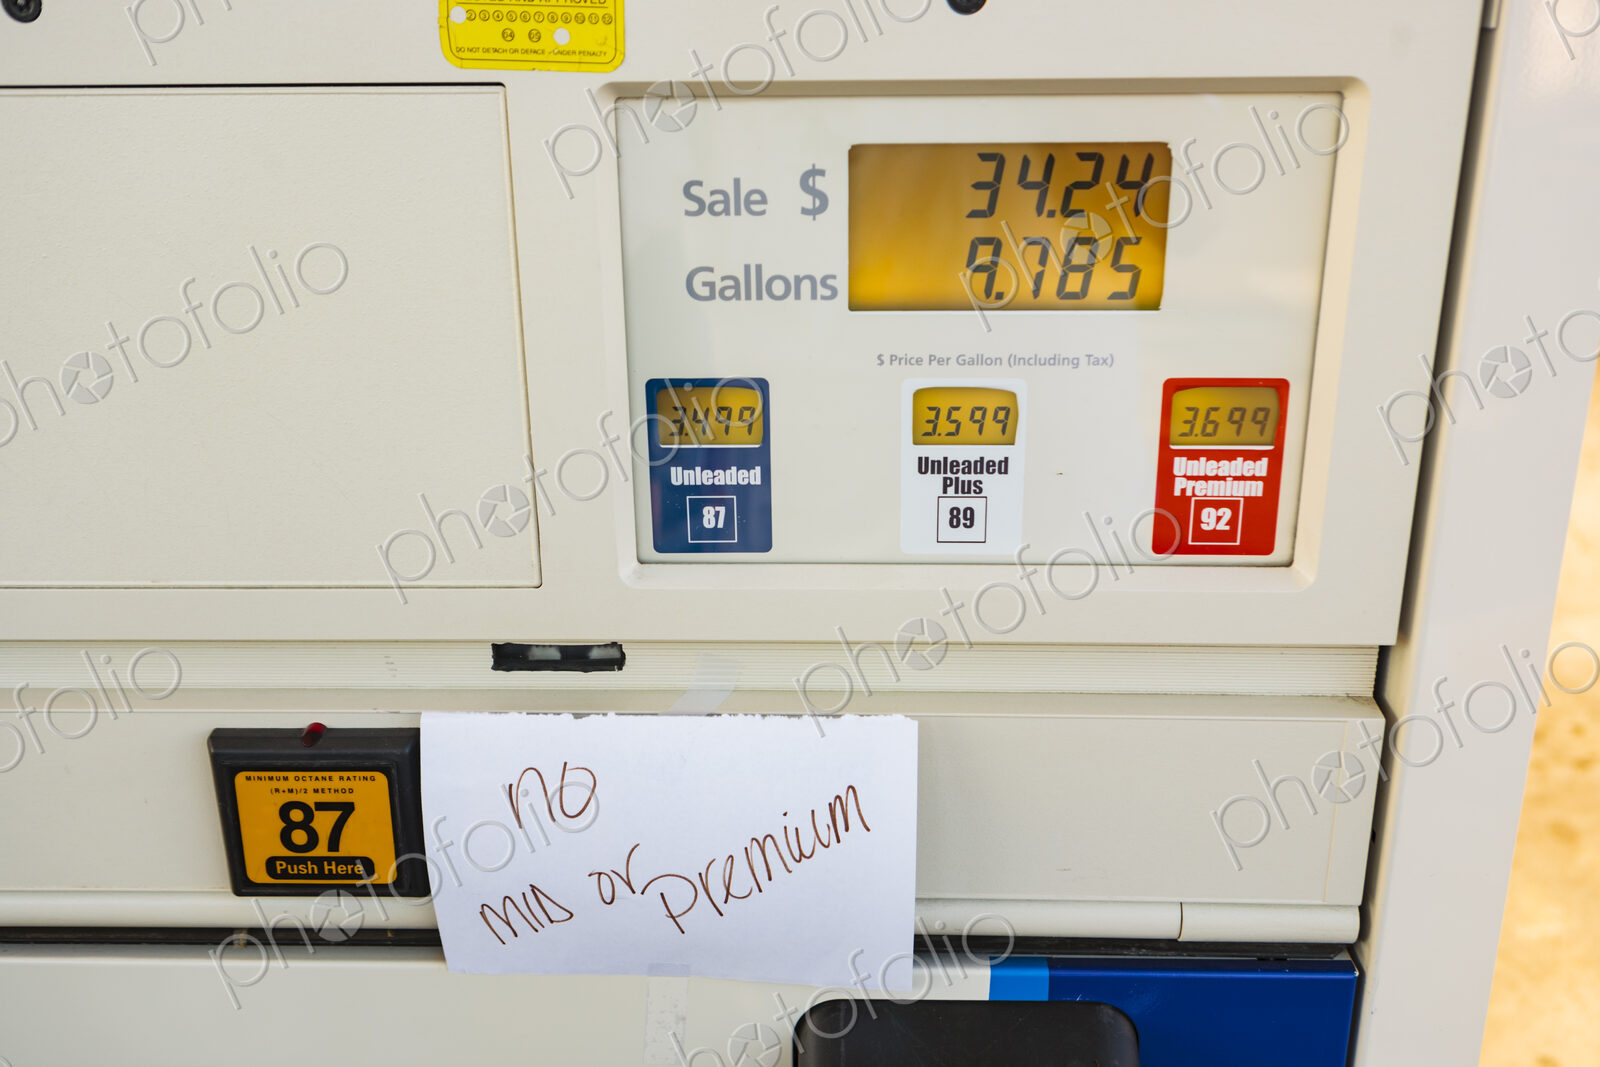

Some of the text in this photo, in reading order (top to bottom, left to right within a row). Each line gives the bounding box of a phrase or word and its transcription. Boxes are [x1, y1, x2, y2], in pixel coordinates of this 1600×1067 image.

[482, 47, 508, 55] DETACH
[521, 48, 546, 56] DEFACE
[578, 50, 607, 58] PENALTY
[683, 164, 829, 220] Sale $
[966, 151, 1154, 218] 34.24
[686, 264, 838, 302] Gallons
[876, 353, 1114, 370] $ Price Per Gallon (Including Tax)
[921, 406, 1010, 437] 3.599
[1178, 406, 1271, 438] 3.699
[670, 466, 761, 486] Unleaded
[917, 457, 1009, 475] Unleaded
[1173, 457, 1268, 478] Unleaded
[942, 477, 983, 495] Plus
[1173, 477, 1264, 498] Premium
[702, 506, 726, 529] 87
[948, 507, 976, 529] 89
[1200, 507, 1231, 531] 92
[278, 800, 355, 854] 87
[275, 861, 364, 875] Push Here
